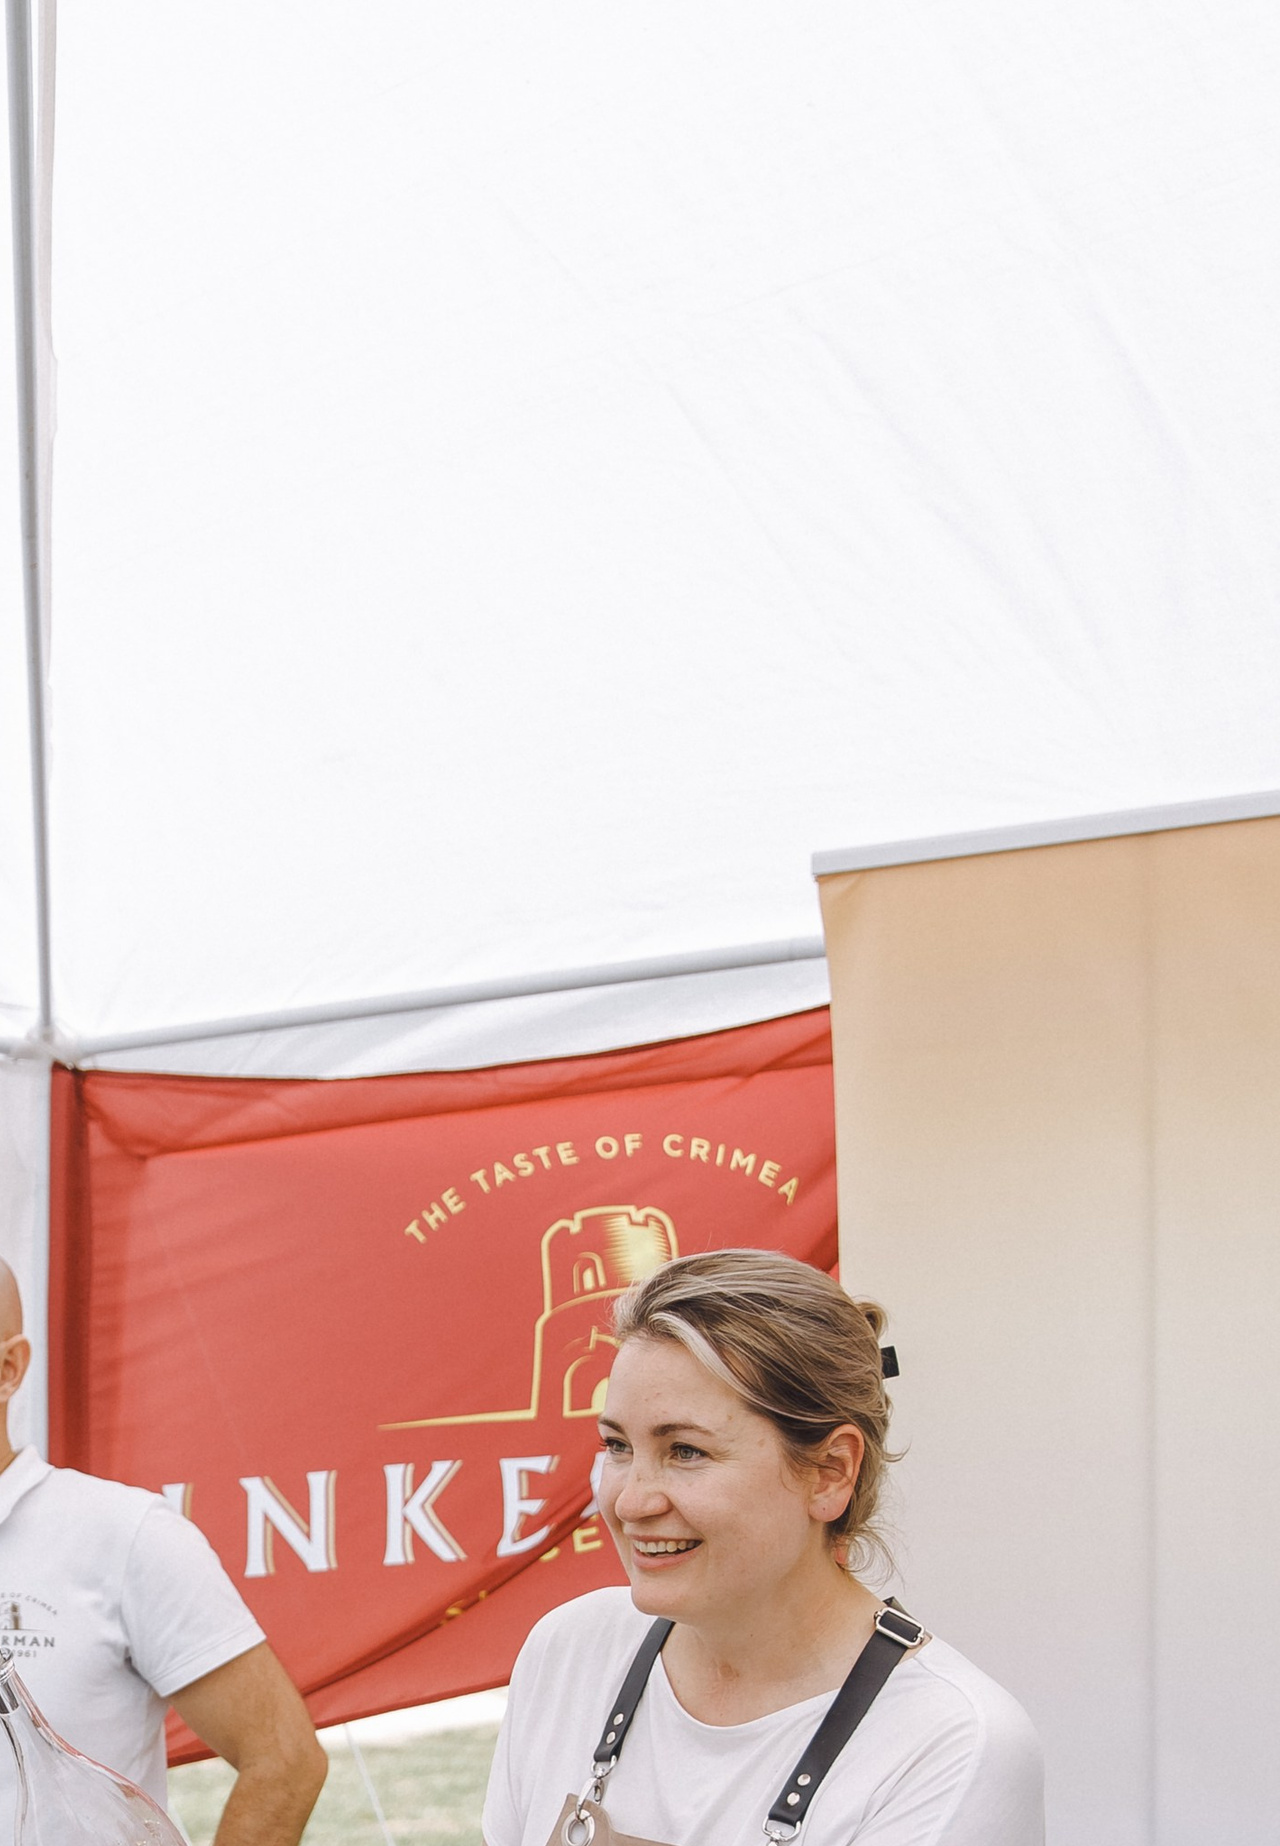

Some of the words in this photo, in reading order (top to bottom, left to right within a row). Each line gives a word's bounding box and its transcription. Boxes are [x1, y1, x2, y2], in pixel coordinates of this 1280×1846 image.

[404, 1187, 467, 1245] THE
[469, 1140, 580, 1195] TASTE
[594, 1132, 643, 1161] OF
[661, 1132, 800, 1206] CRIMEA
[161, 1454, 607, 1579] NKE
[25, 1594, 58, 1616] CRIMEA
